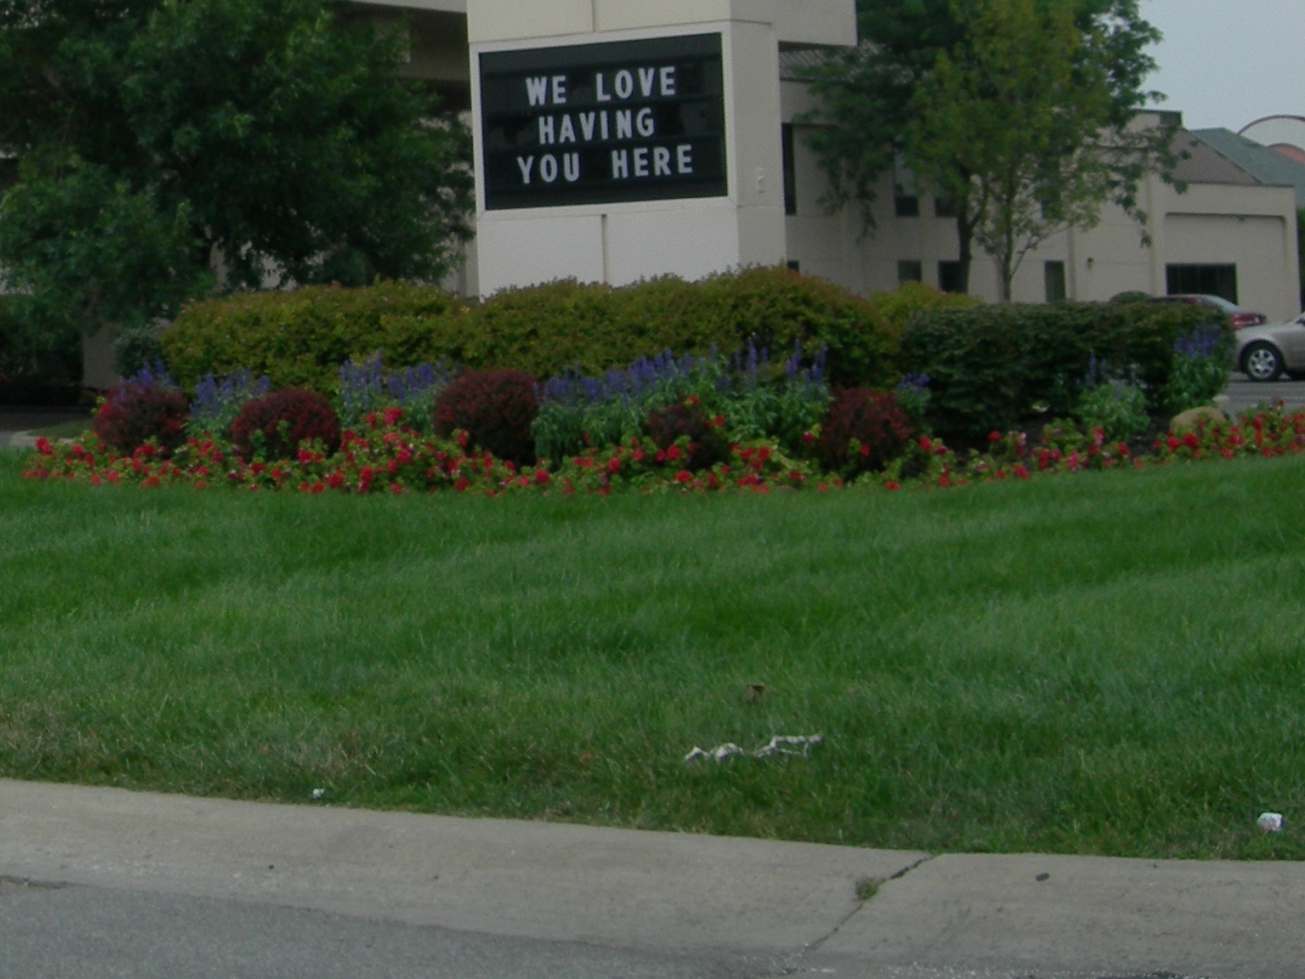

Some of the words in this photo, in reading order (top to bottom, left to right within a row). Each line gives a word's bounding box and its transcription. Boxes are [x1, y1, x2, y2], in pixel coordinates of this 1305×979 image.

[525, 74, 568, 107] WE
[596, 65, 677, 102] LOVE
[538, 106, 656, 146] HAVING
[517, 151, 581, 185] YOU
[611, 143, 694, 180] HERE
